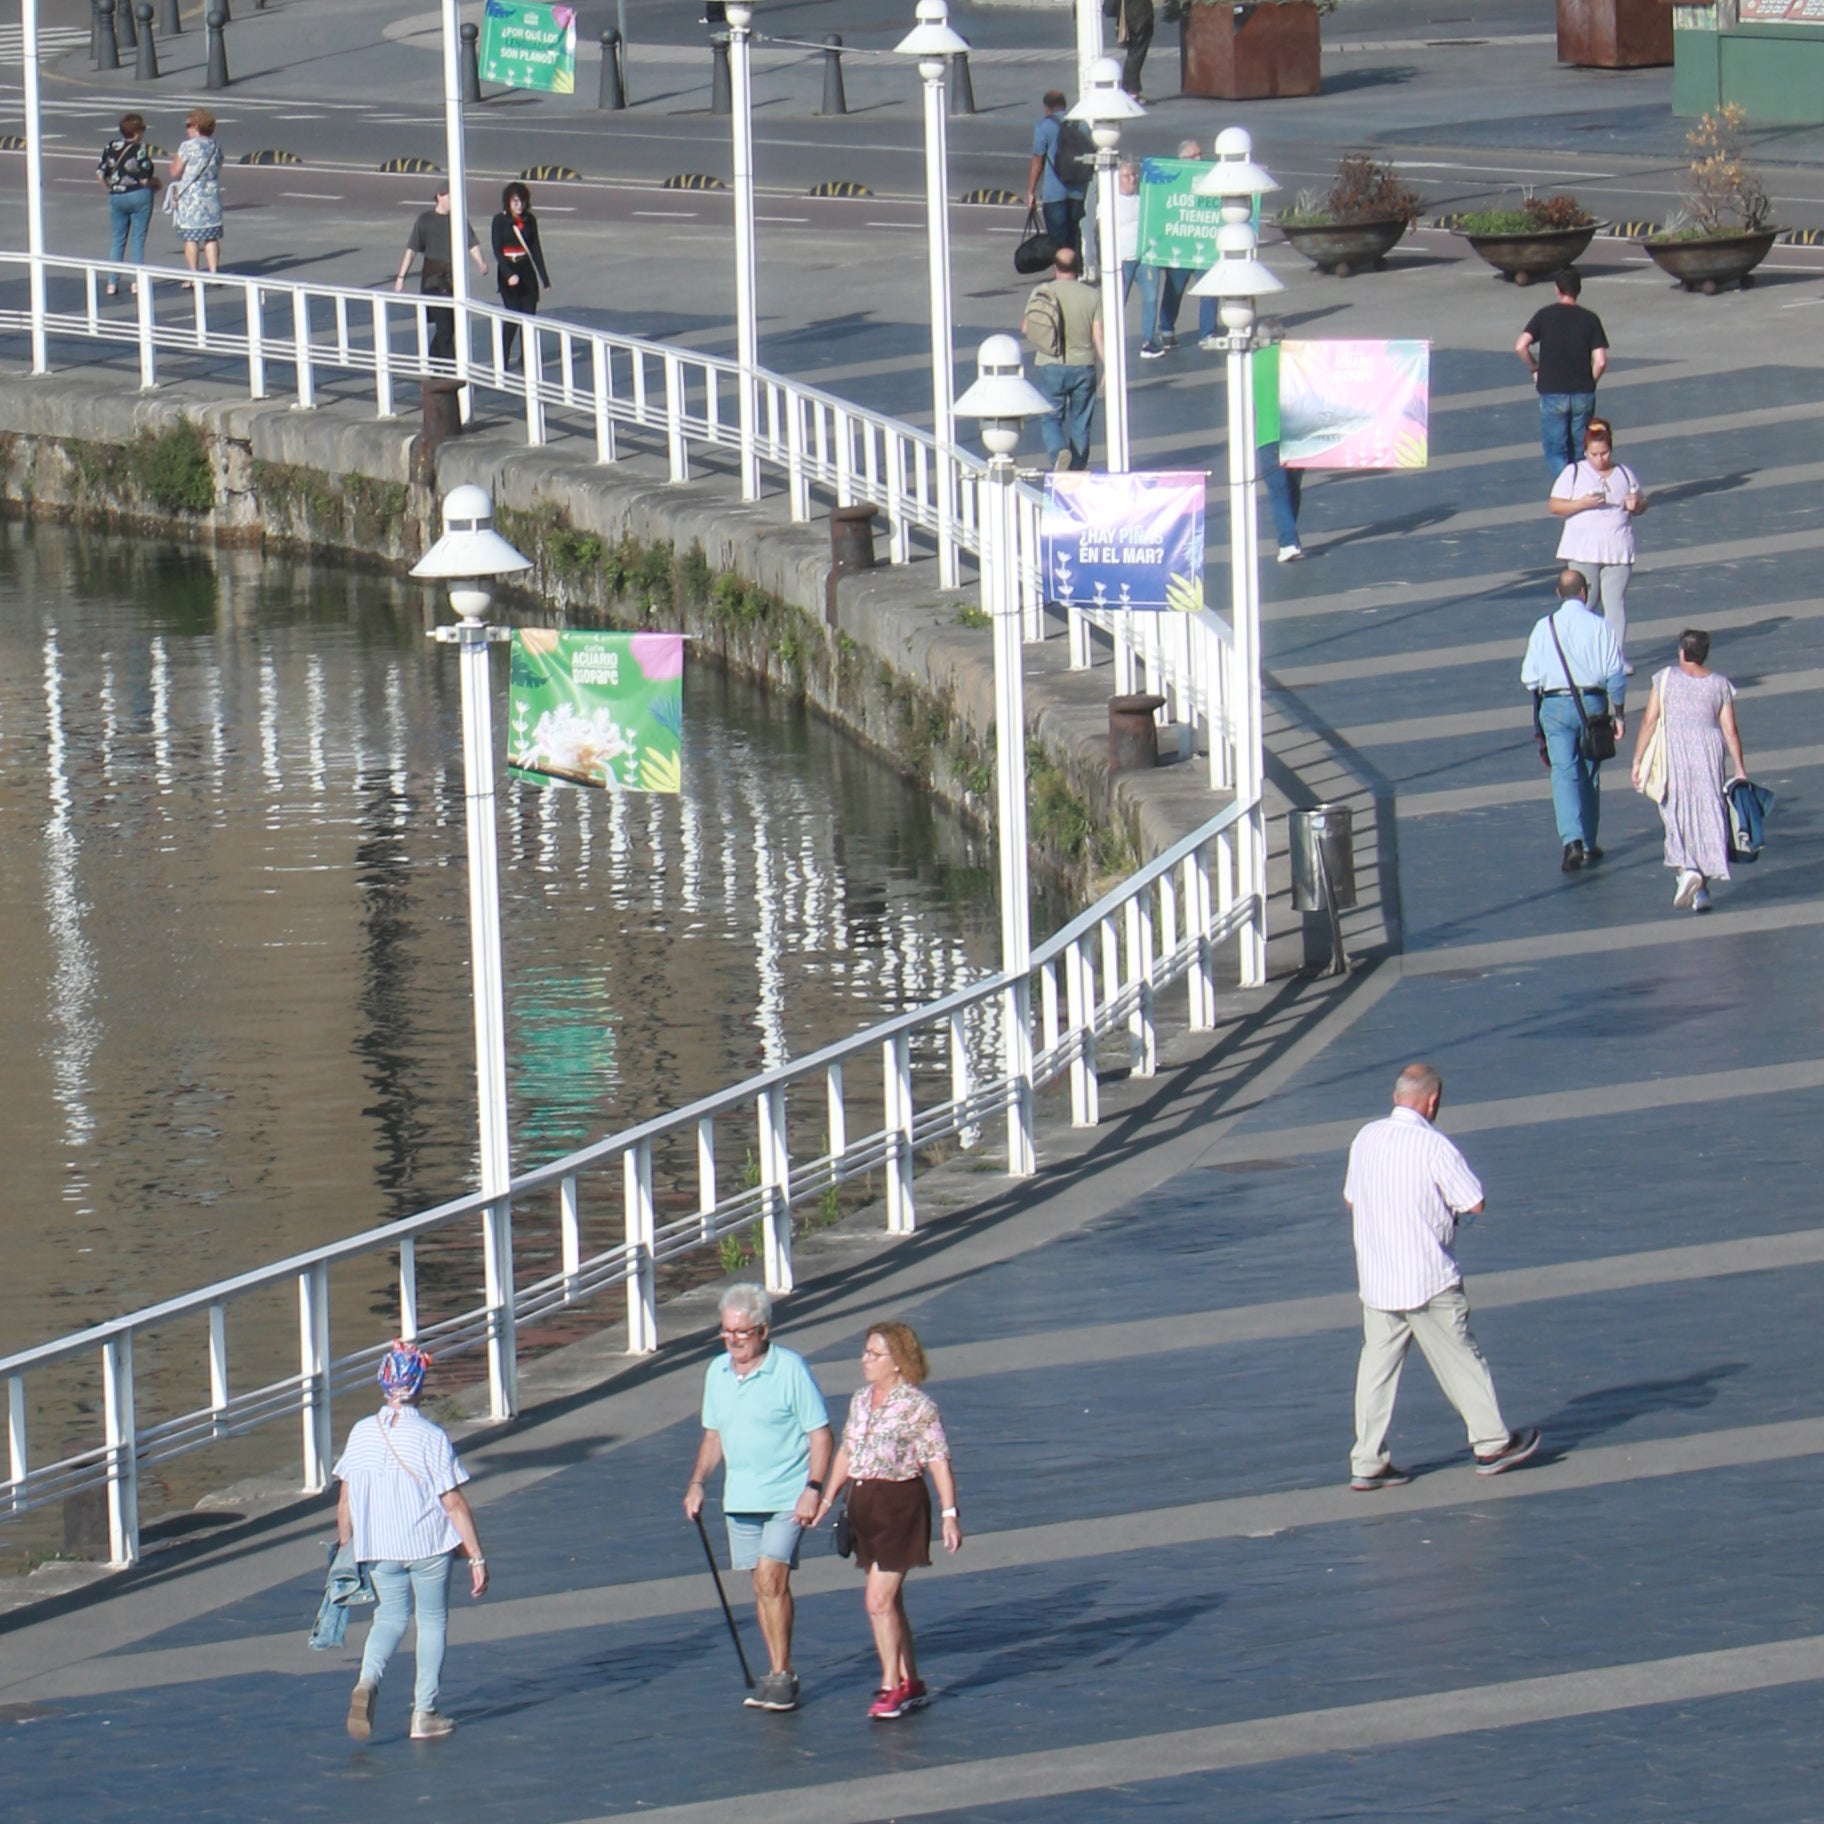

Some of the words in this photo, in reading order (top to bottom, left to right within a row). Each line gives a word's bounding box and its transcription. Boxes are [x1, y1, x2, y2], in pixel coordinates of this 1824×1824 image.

[500, 47, 518, 60] SON
[1166, 193, 1195, 209] ¿LOS
[1178, 209, 1221, 224] TIENEN
[1079, 527, 1117, 547] ¿HAY
[1079, 547, 1099, 564] EN
[1102, 547, 1121, 564] EL
[1122, 547, 1165, 565] MAR?
[572, 651, 619, 667] ACUARIO
